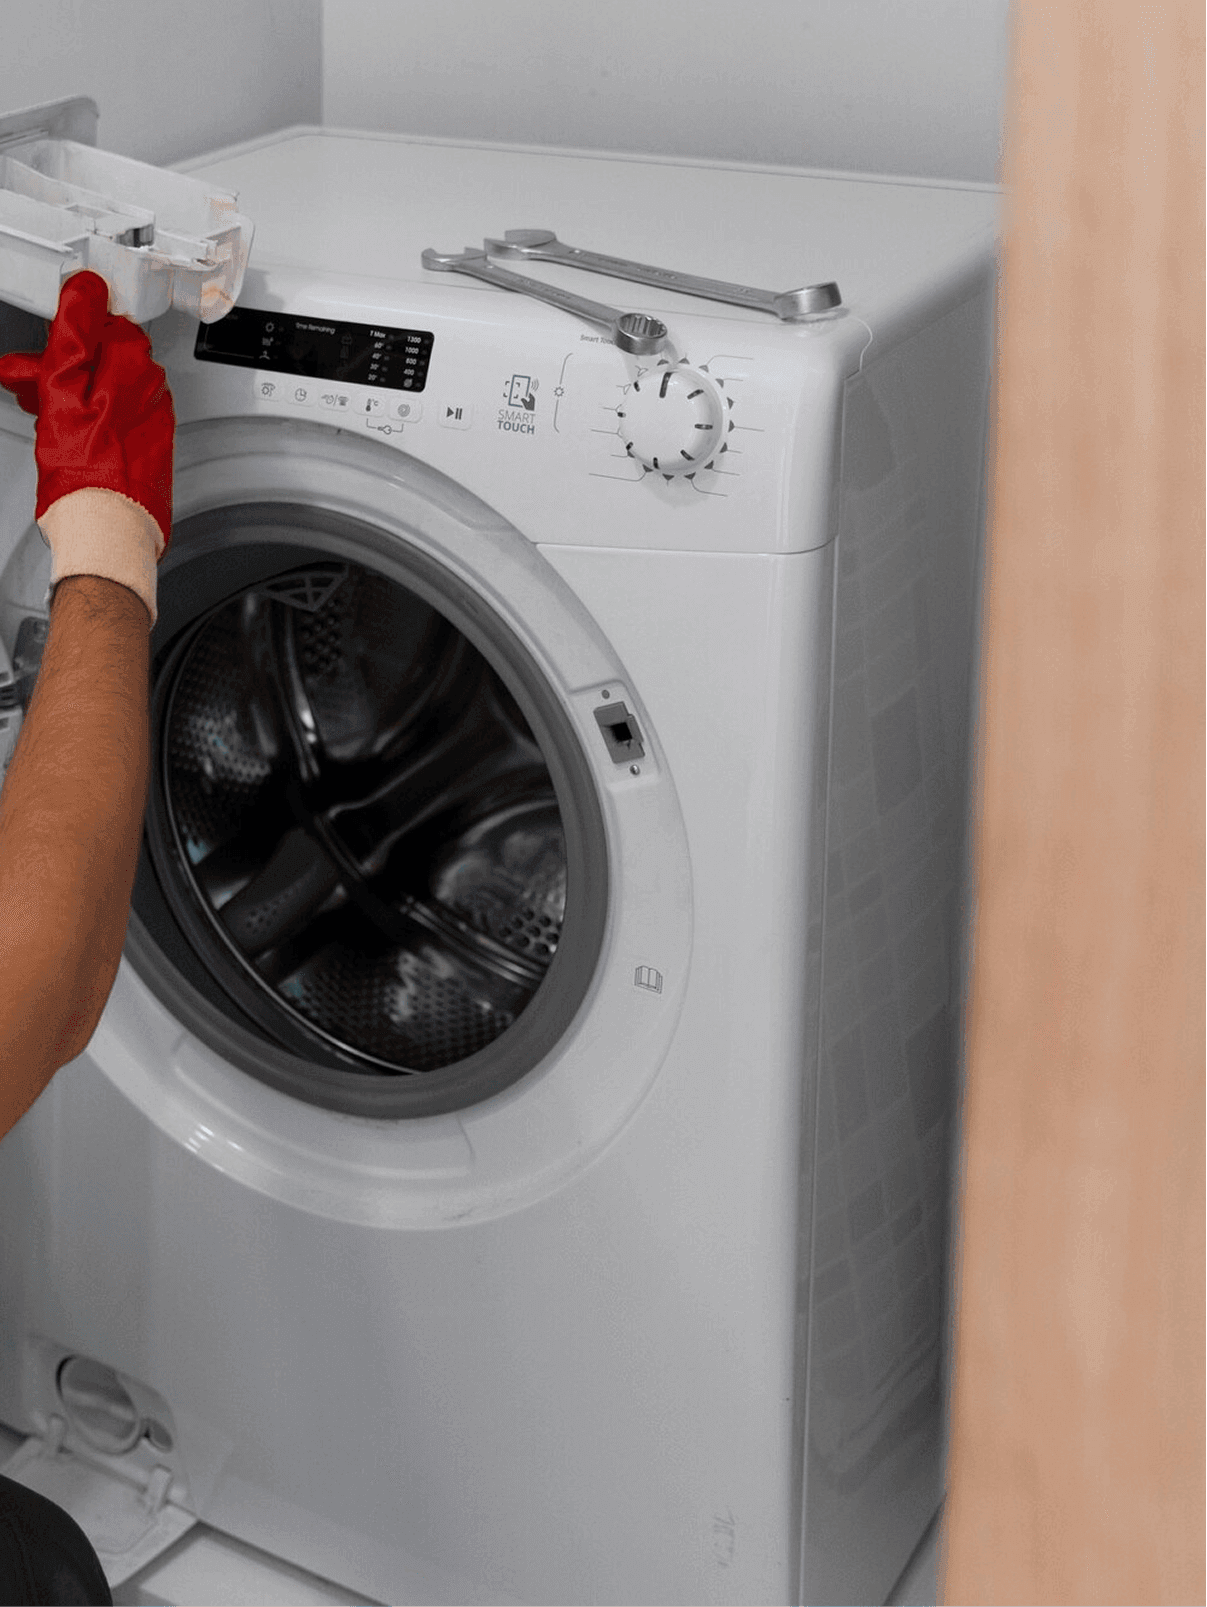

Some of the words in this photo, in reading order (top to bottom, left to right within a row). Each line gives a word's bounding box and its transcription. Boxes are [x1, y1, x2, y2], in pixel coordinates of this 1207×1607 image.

[308, 324, 336, 335] Remaining
[407, 336, 421, 344] 1300
[580, 334, 599, 343] Smart
[405, 346, 419, 354] 1000
[498, 409, 535, 424] SMART
[496, 420, 535, 435] TOUCH
